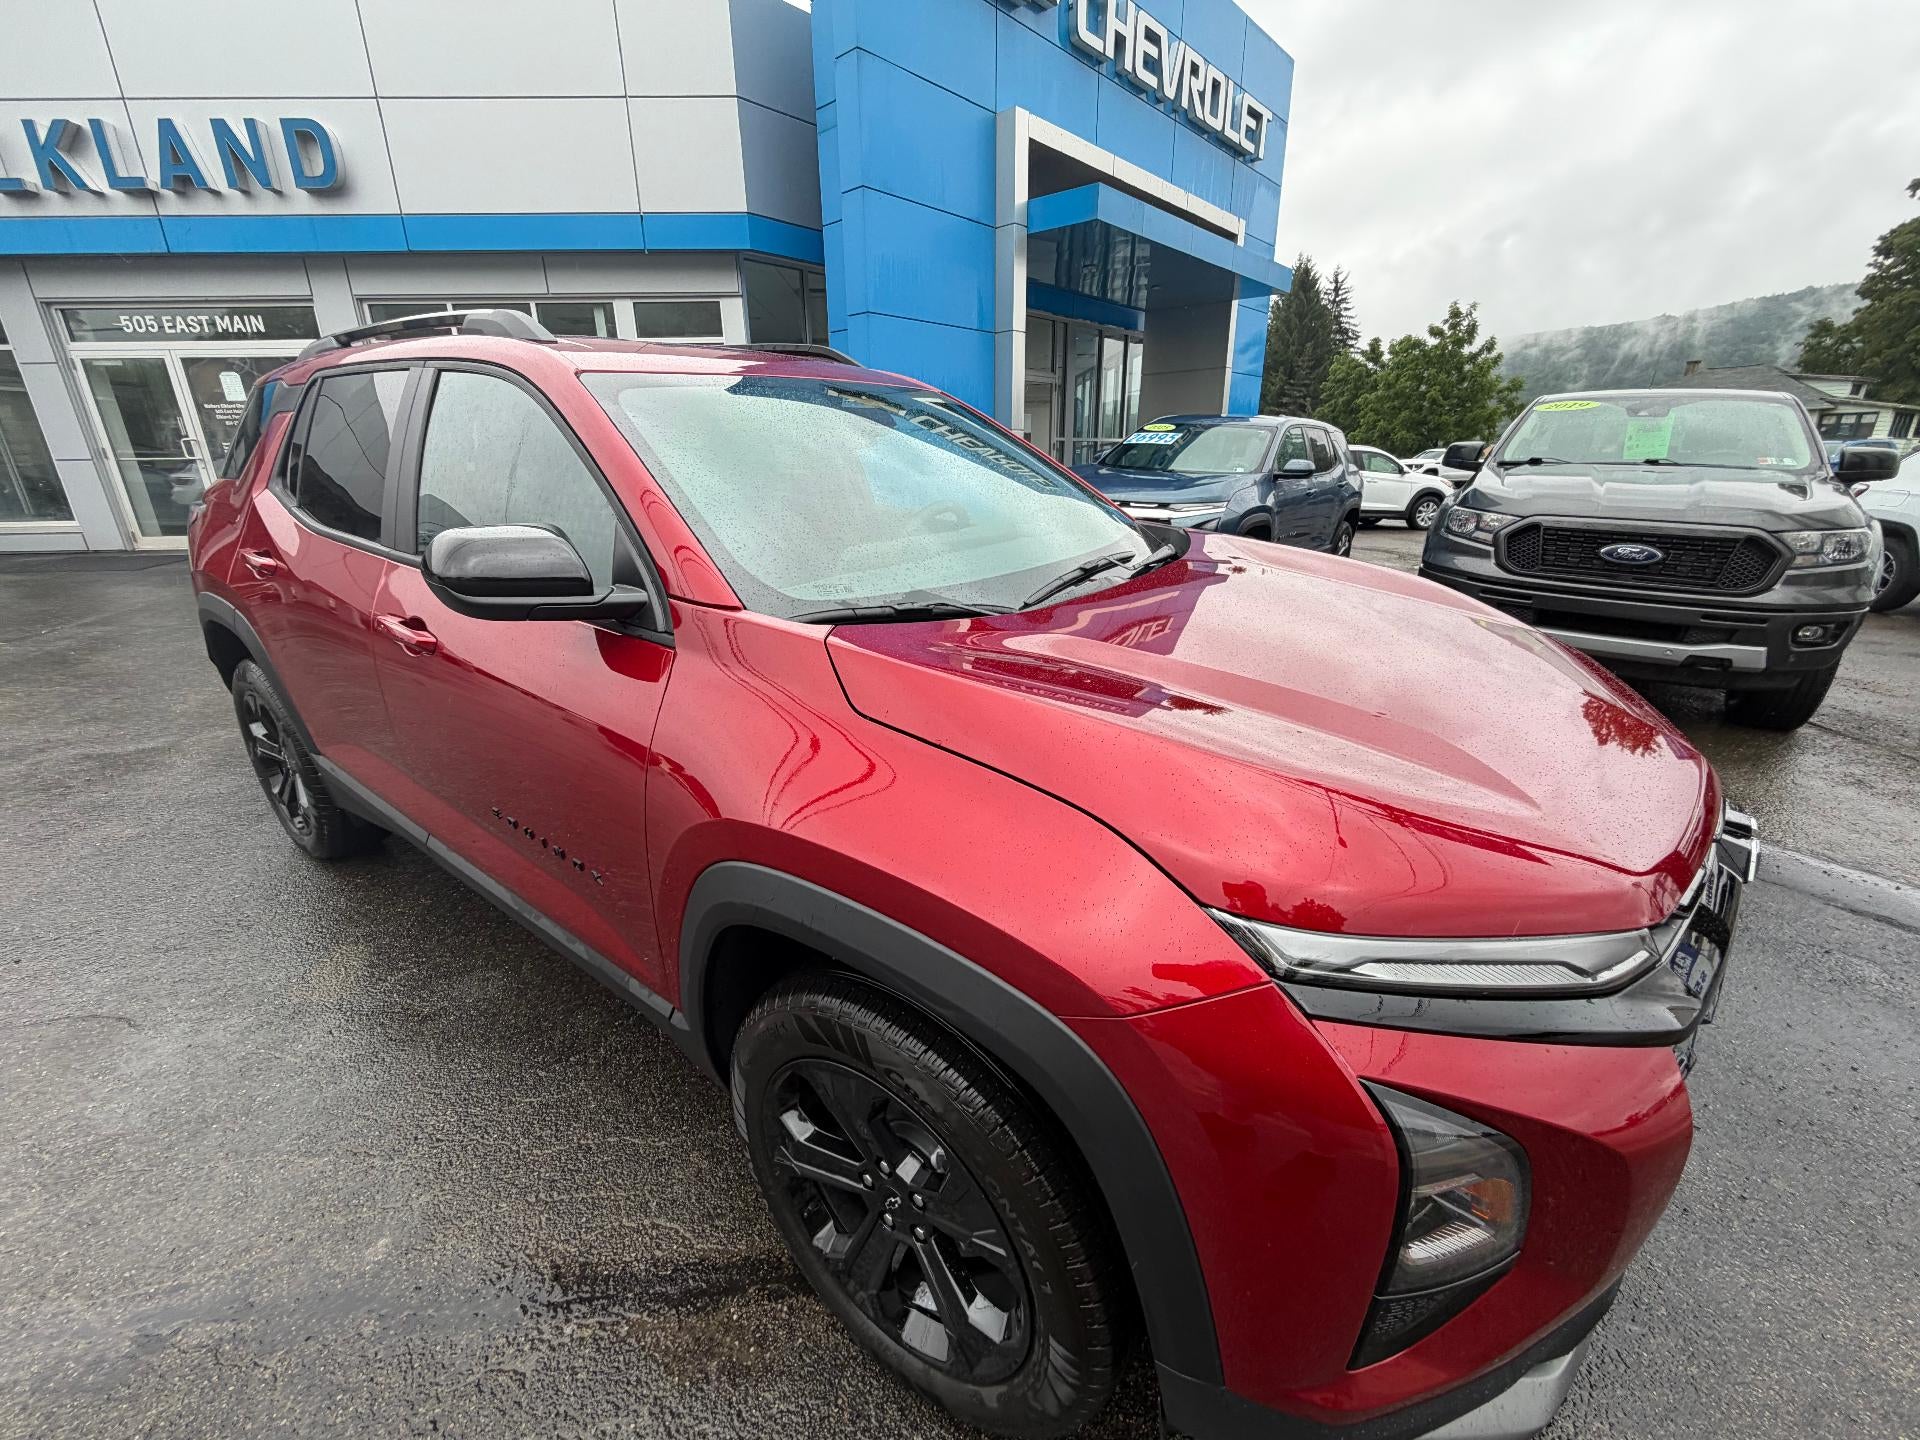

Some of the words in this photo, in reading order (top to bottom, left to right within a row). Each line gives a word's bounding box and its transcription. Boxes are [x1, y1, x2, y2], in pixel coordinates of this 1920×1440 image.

[1076, 0, 1273, 161] CHEVROLET
[120, 315, 159, 333] 505
[161, 315, 210, 334] EAST
[214, 314, 266, 333] MAIN
[1612, 547, 1649, 560] Ford
